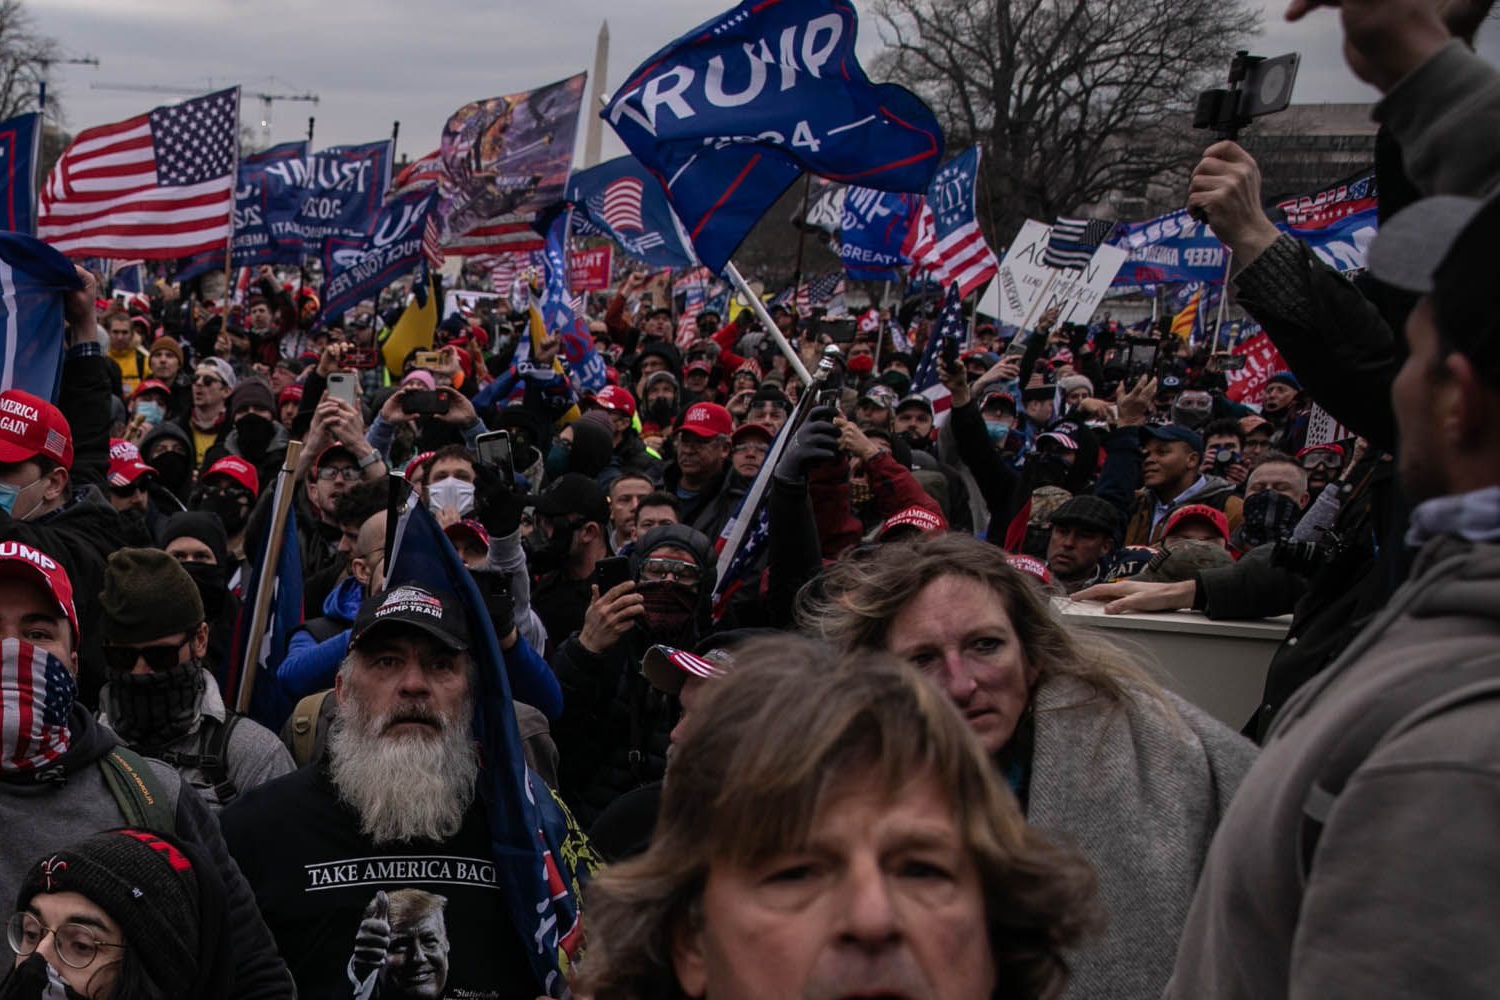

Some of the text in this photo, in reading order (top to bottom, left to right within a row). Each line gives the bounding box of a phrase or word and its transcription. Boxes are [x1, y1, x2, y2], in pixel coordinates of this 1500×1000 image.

[907, 509, 940, 526] AMERICA
[375, 605, 443, 619] TRUMP TRAIN
[131, 771, 154, 805] ARMOUR
[308, 864, 358, 886] TAKE
[363, 860, 452, 880] AMERICA
